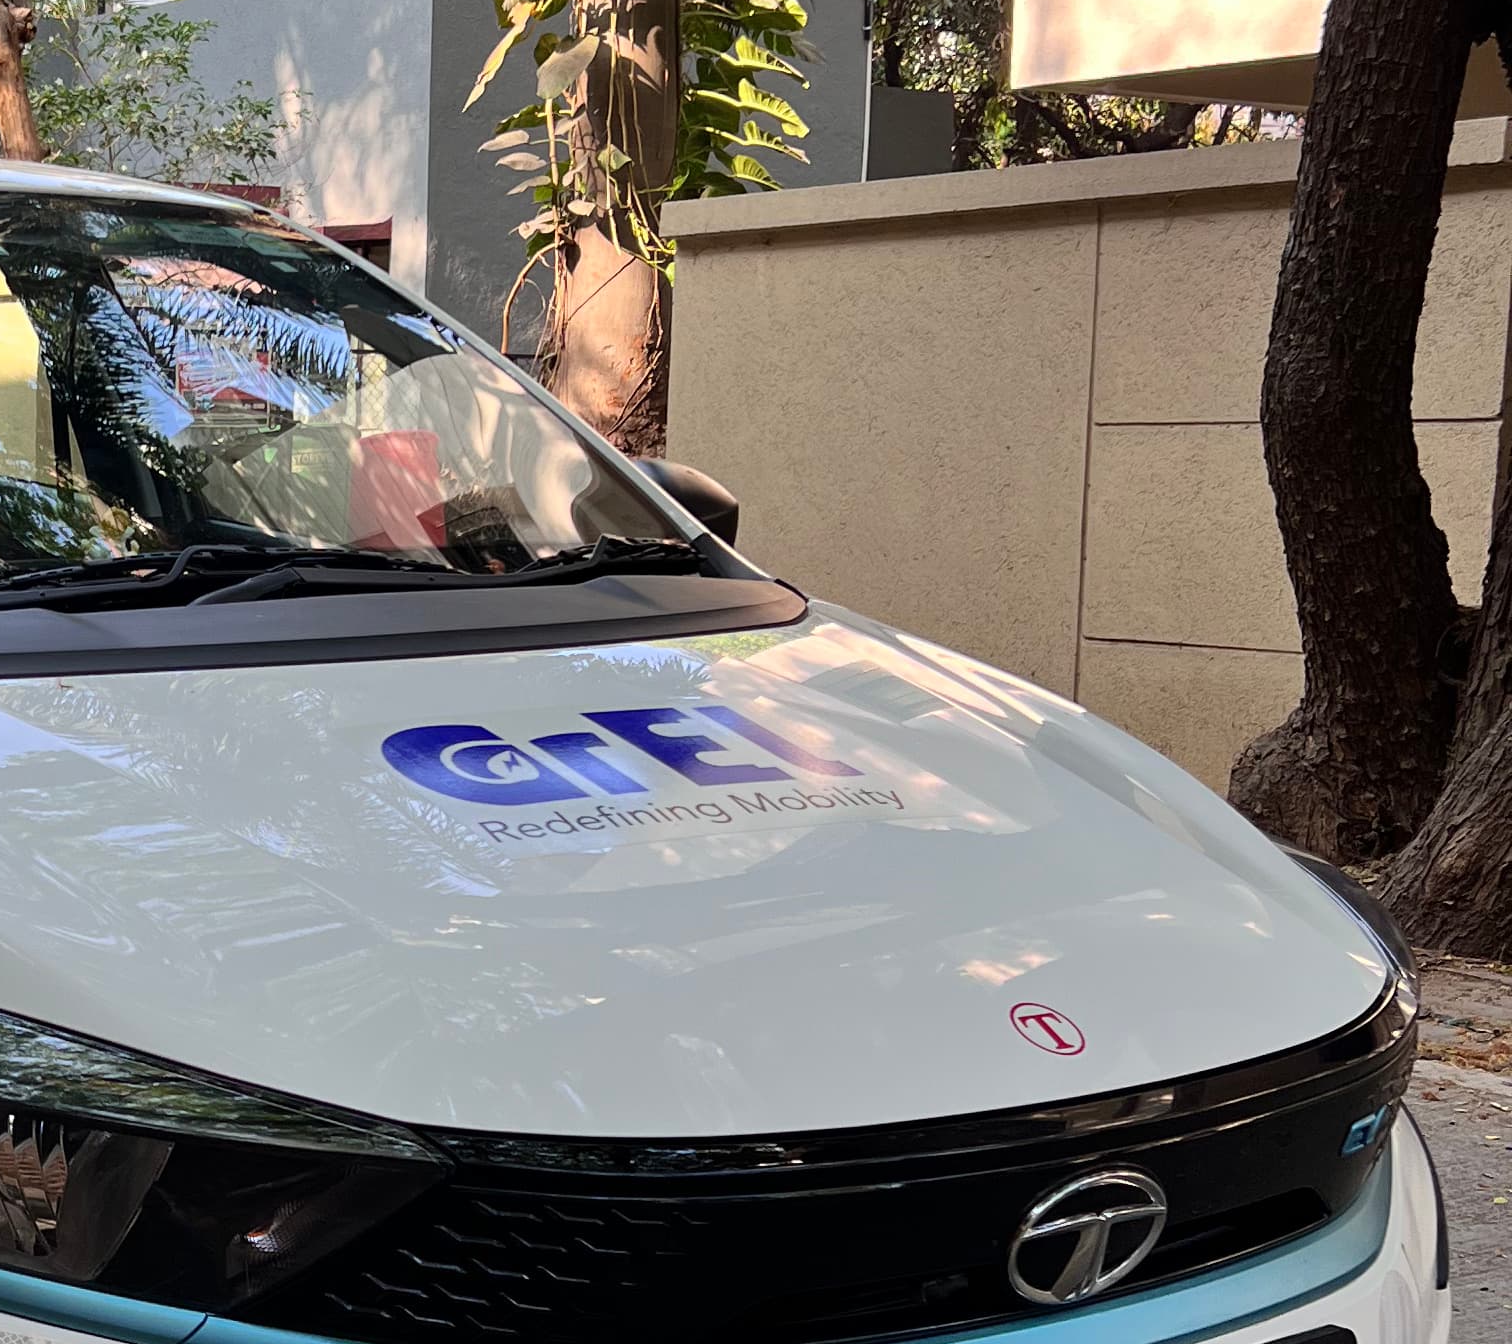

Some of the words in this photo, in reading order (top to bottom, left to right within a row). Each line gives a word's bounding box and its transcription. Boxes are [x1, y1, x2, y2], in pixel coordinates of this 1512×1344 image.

[478, 802, 732, 844] Redefining
[730, 785, 905, 814] Mobility
[1016, 1011, 1077, 1051] T
